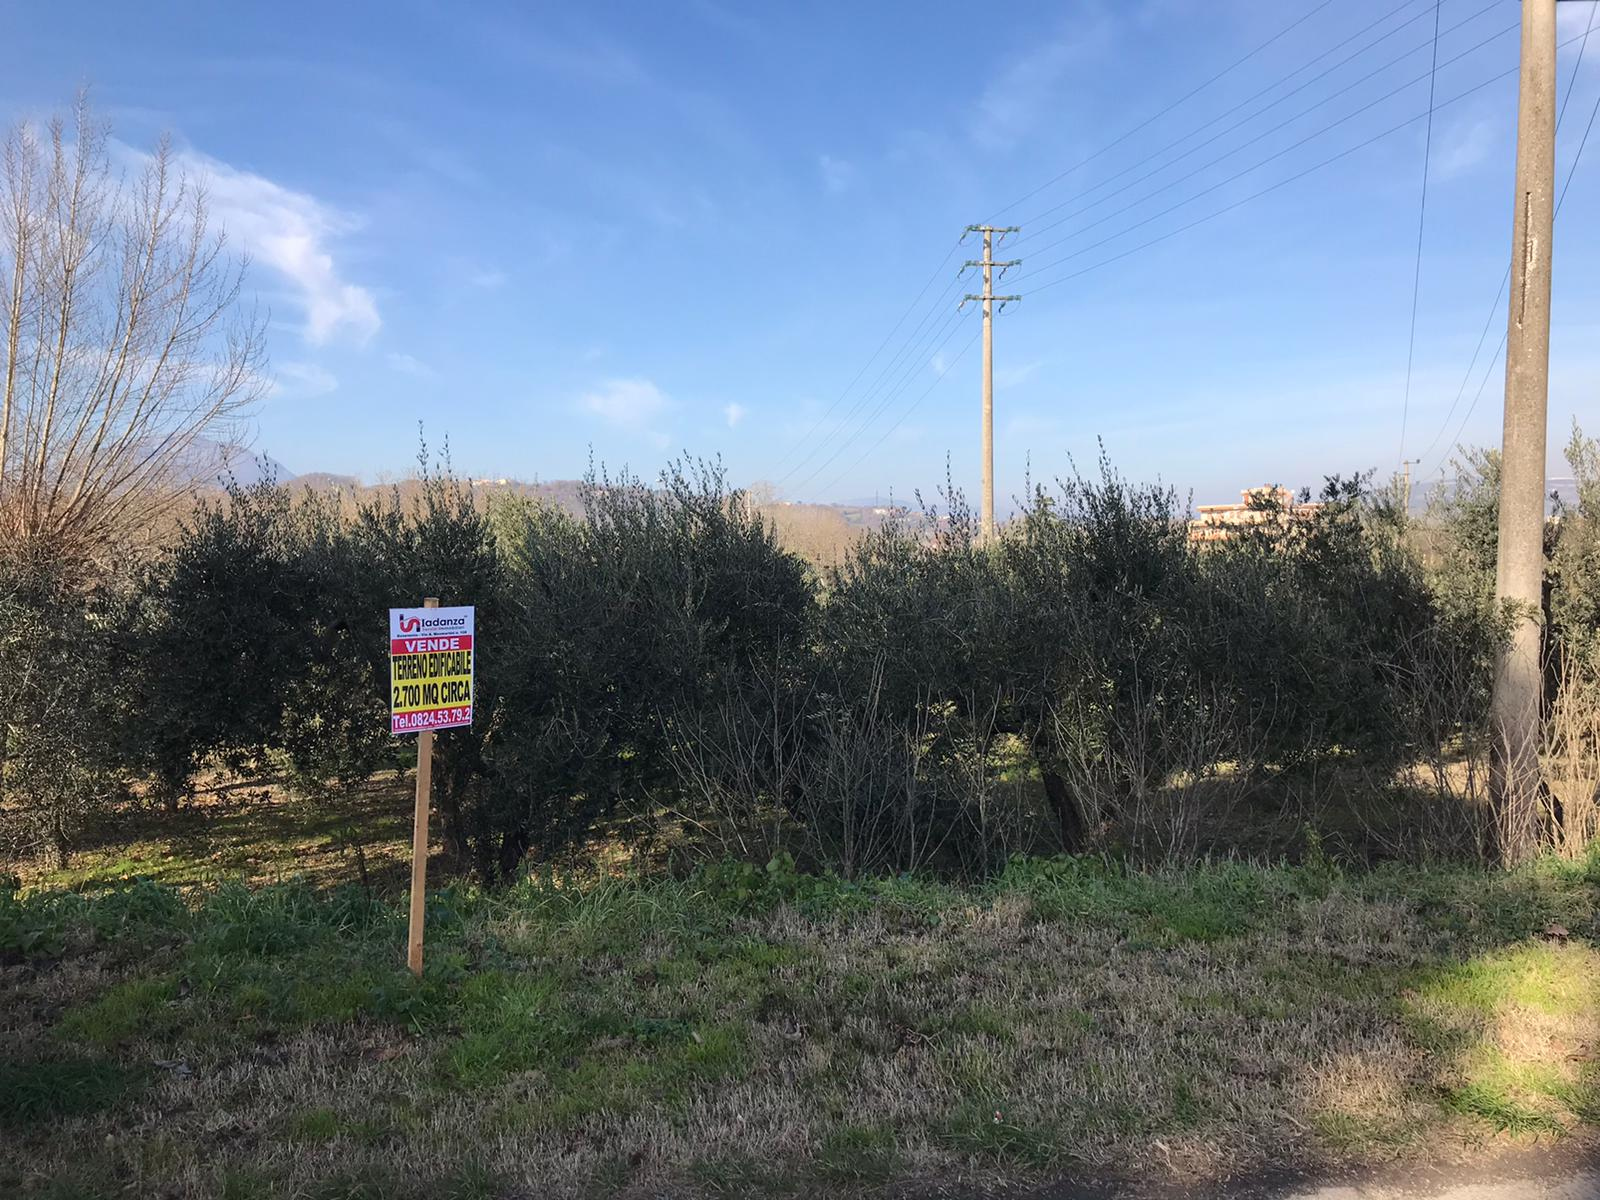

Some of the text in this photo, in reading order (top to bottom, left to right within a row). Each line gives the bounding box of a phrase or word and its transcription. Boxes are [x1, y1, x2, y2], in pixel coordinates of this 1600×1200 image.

[405, 638, 459, 652] VENDE
[393, 651, 471, 680] TERRENO EDIFICABILE
[393, 680, 471, 708] 2.700 MQ CIRCA
